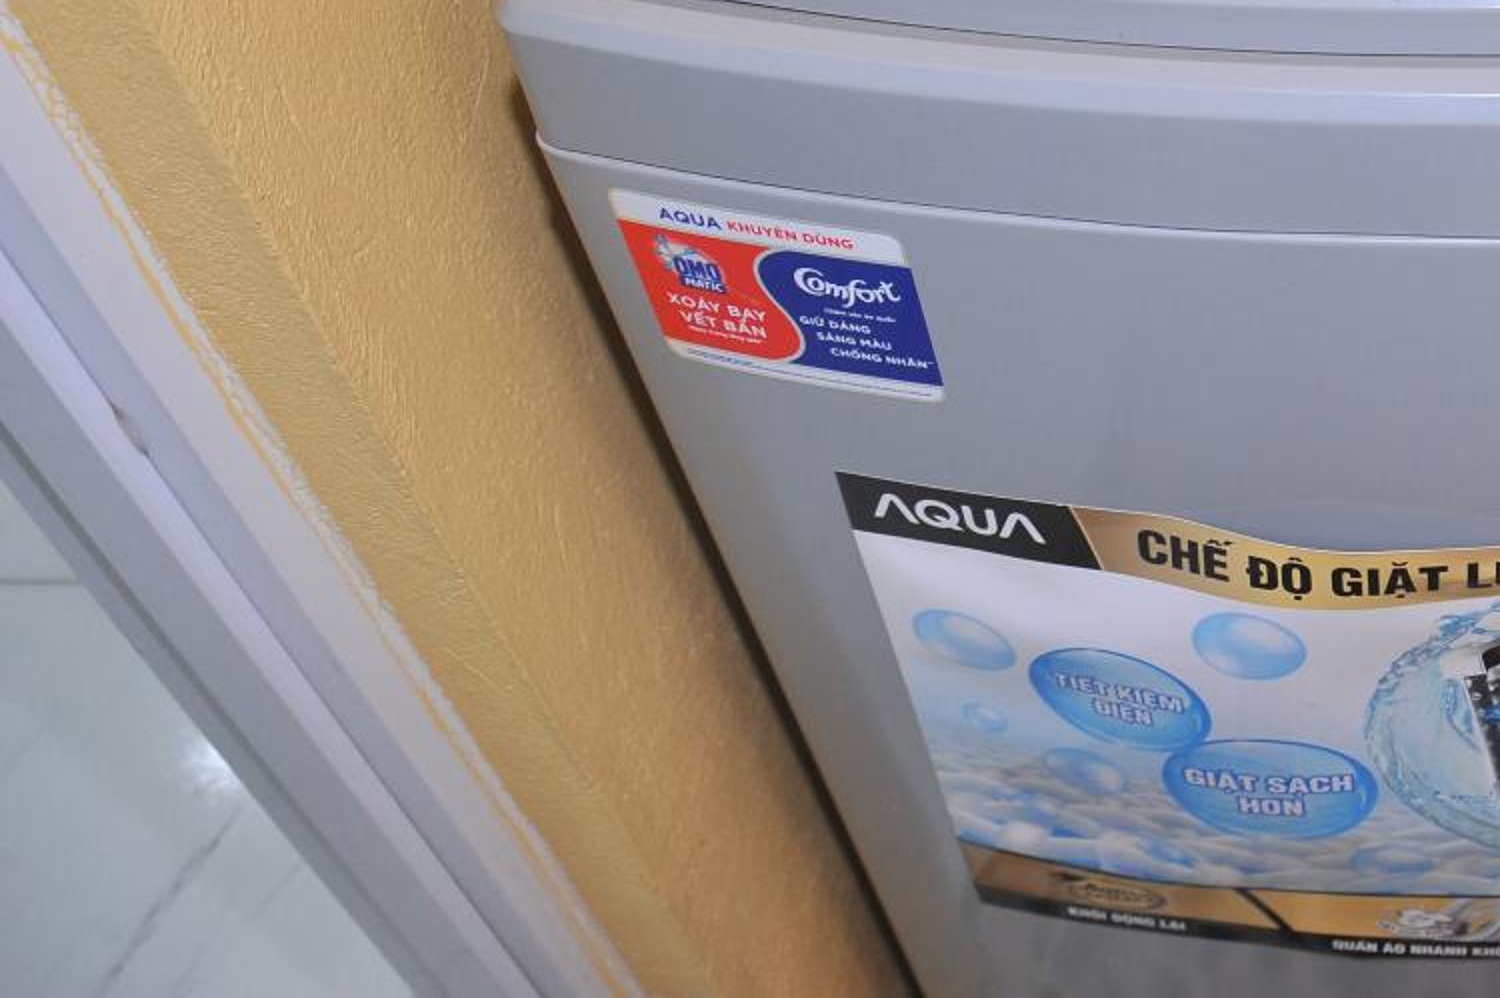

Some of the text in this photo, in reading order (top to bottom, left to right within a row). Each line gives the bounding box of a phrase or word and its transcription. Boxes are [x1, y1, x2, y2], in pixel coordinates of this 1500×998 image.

[659, 207, 722, 231] AQUA
[673, 256, 722, 281] OMO
[684, 277, 727, 293] MATIC
[793, 267, 901, 308] Comfort
[728, 304, 766, 322] BAY
[874, 493, 1046, 545] AQUA
[1245, 554, 1313, 601] ĐỘ
[1331, 561, 1448, 599] GIẶT
[1410, 944, 1467, 956] NHANH
